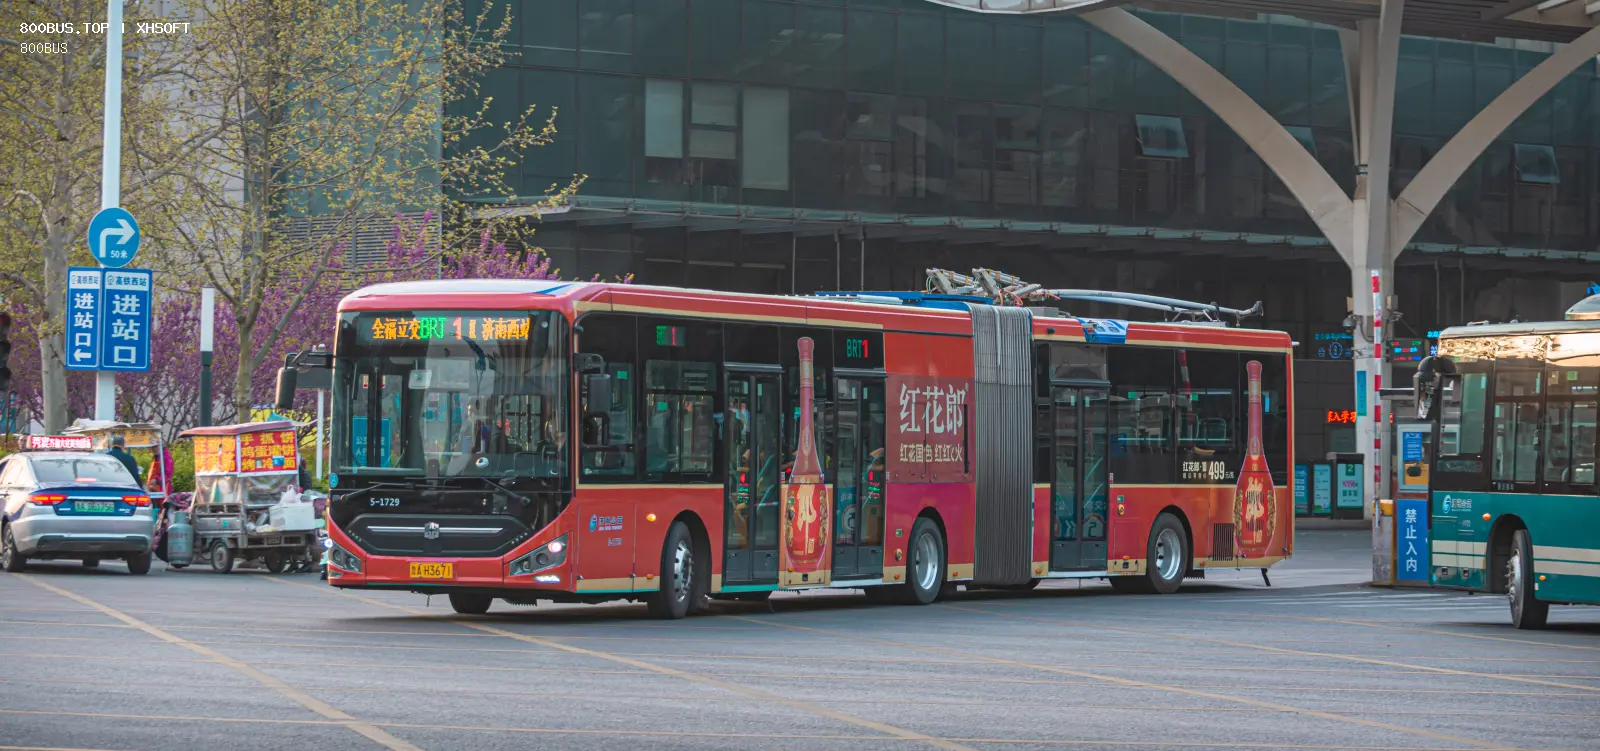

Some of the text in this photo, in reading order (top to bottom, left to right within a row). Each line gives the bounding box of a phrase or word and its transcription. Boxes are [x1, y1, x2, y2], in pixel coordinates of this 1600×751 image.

[110, 250, 128, 259] 50米
[115, 276, 147, 286] 高铁西站
[74, 292, 95, 347] 进站口
[111, 294, 141, 364] 进站口
[372, 317, 420, 340] 全福立交
[420, 317, 446, 339] BRT
[453, 317, 462, 340] 1
[481, 317, 531, 341] 济南西站
[900, 383, 966, 435] 红花郎
[900, 443, 933, 463] 红花国色
[1208, 461, 1225, 480] 499
[370, 497, 400, 507] 5-1729
[1405, 508, 1418, 572] 禁止入内
